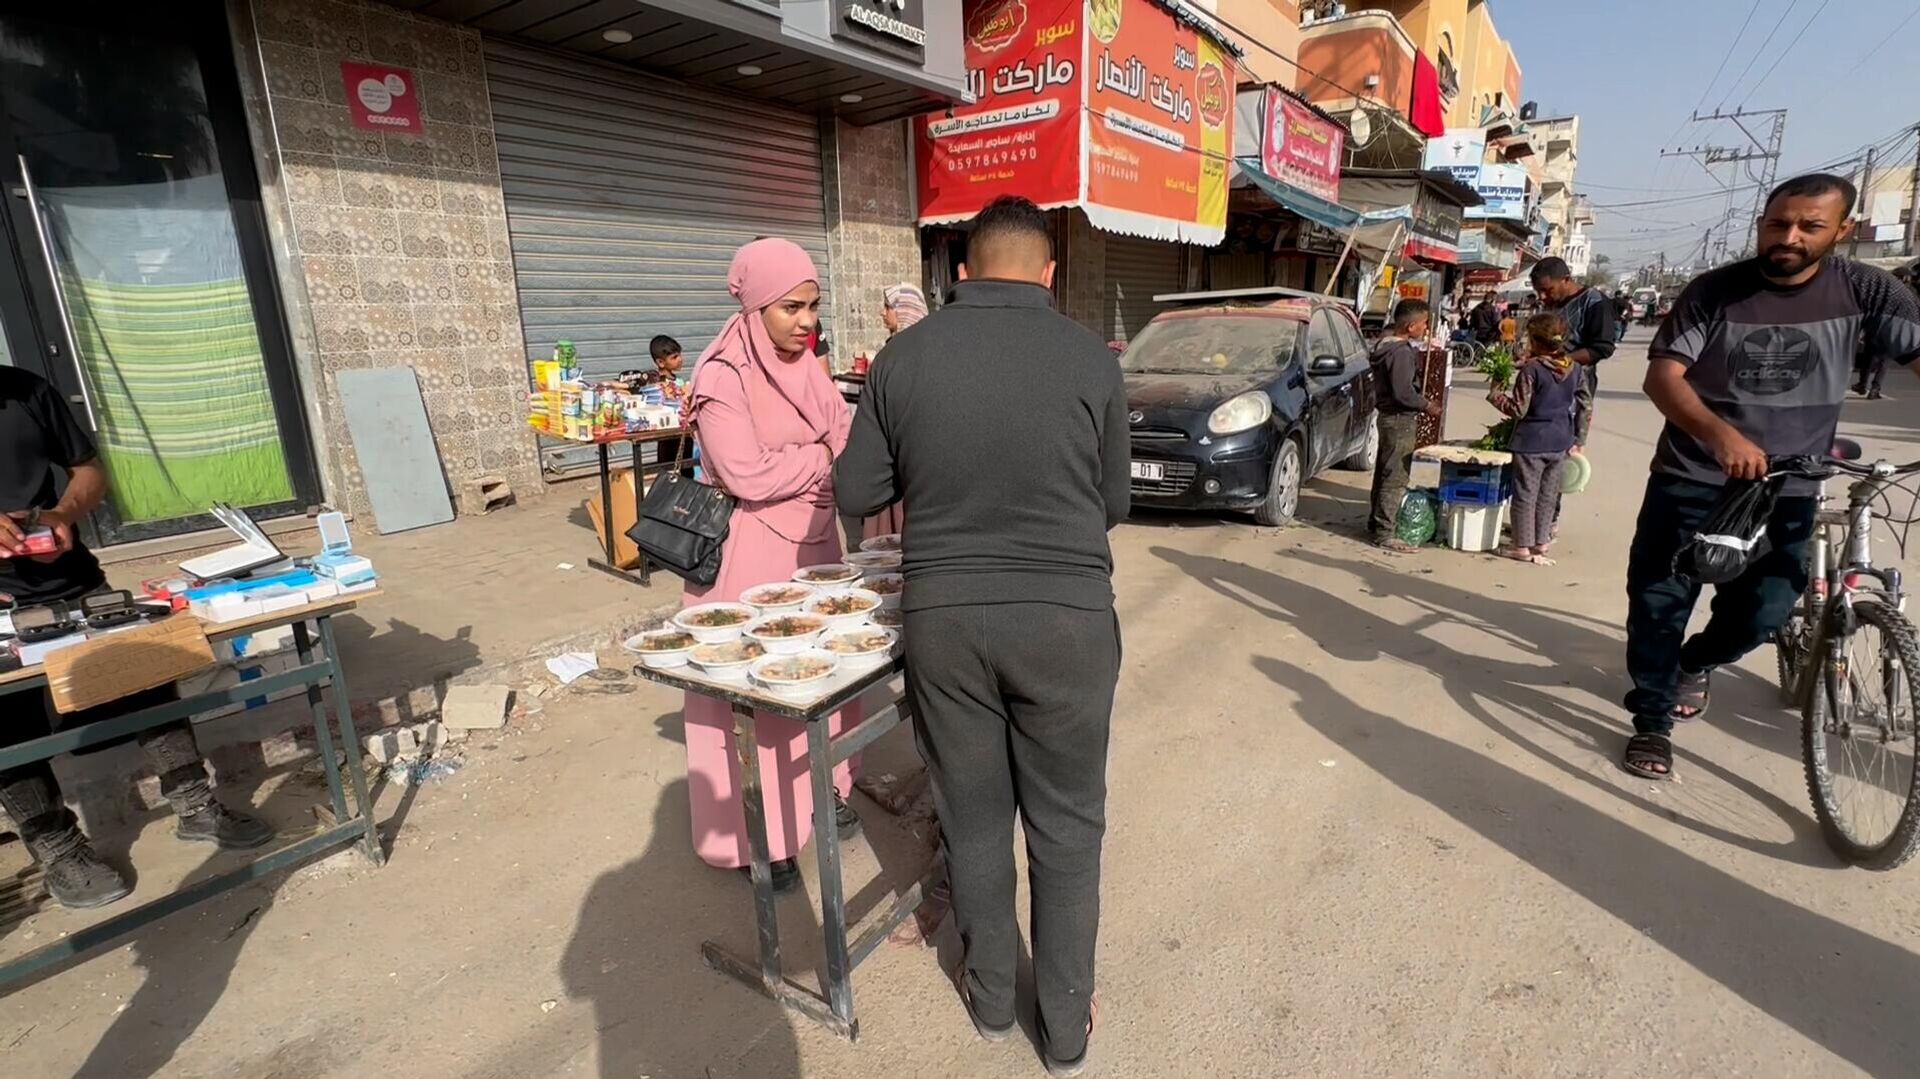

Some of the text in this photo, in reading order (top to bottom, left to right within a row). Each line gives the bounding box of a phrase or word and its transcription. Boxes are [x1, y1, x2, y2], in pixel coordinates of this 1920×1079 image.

[889, 18, 926, 46] MARKET
[1034, 20, 1075, 47] سوبر
[1174, 44, 1195, 70] سوبر
[992, 53, 1075, 95] ماركت
[1097, 48, 1192, 123] ماركت الأنصار
[934, 103, 1050, 134] لكل ما تحتاجه الأسرة
[948, 147, 1037, 171] 0597849490
[1737, 367, 1801, 379] adidas
